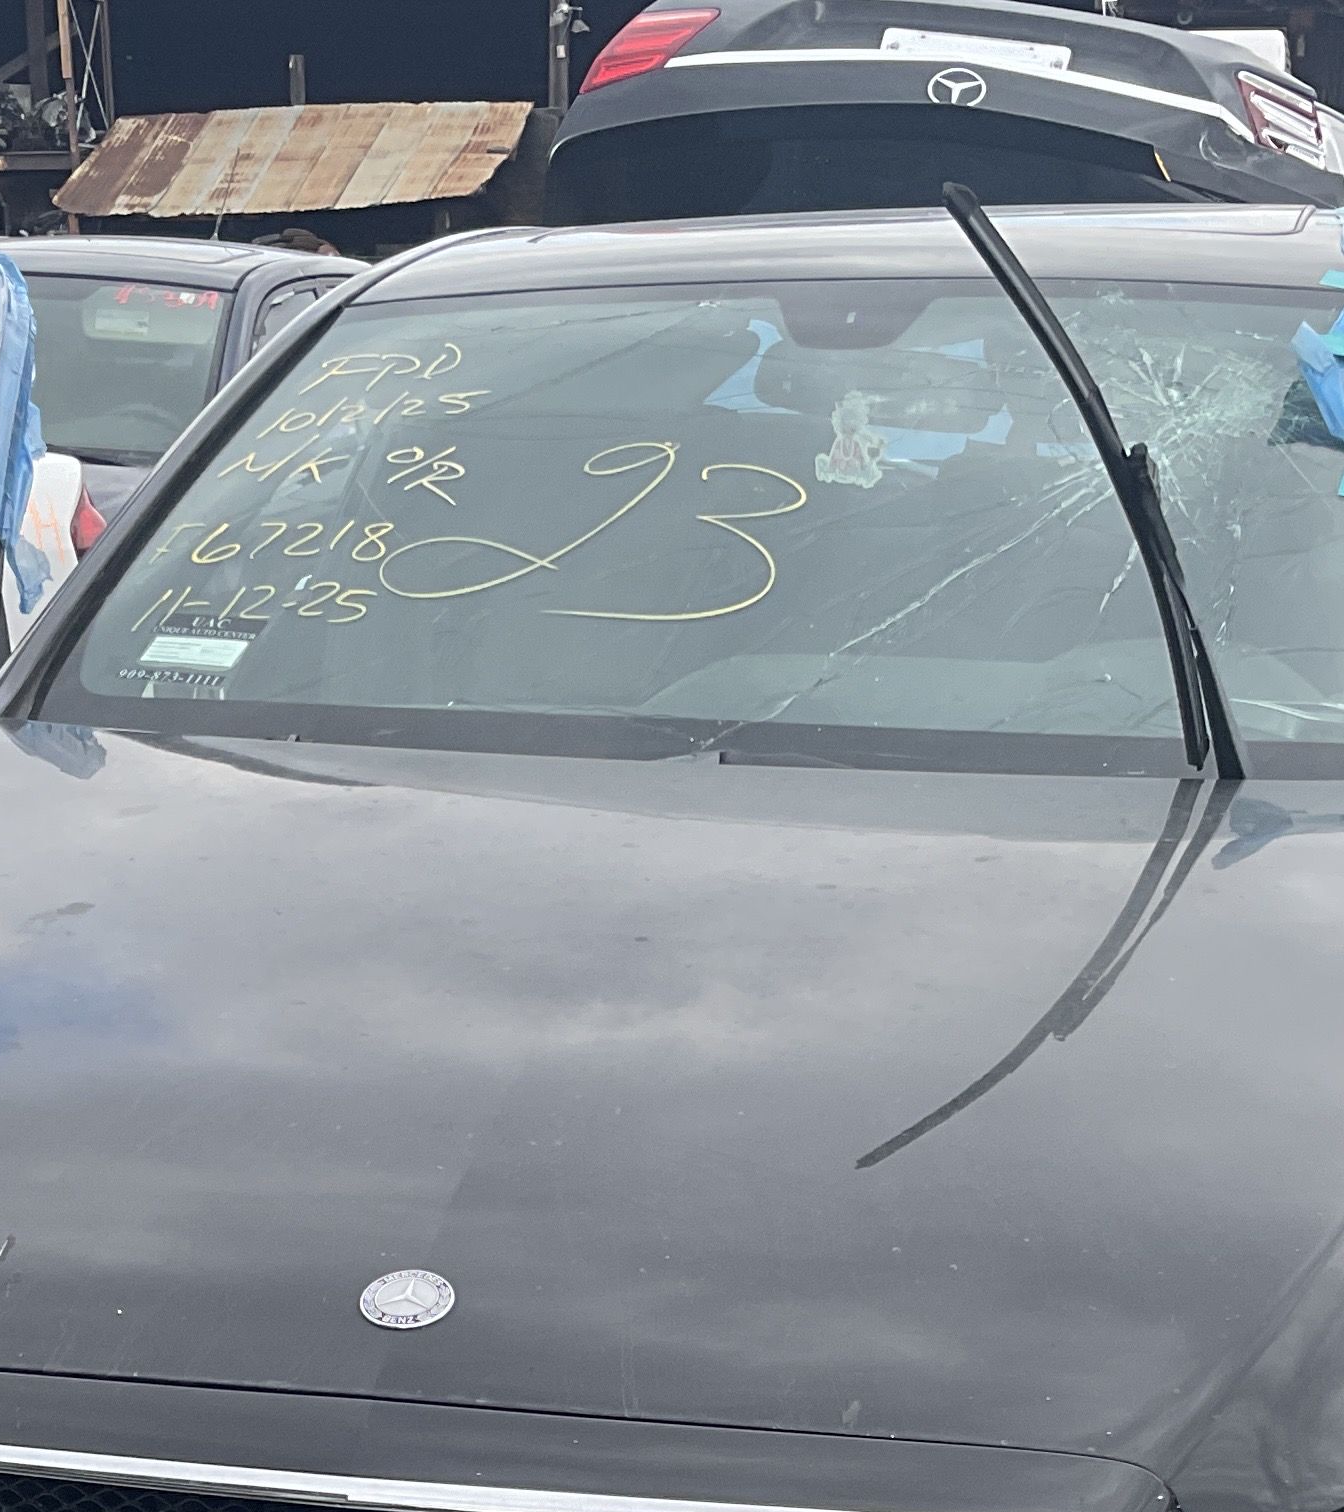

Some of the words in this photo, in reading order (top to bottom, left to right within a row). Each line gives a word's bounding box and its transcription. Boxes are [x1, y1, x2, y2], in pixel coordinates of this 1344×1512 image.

[256, 390, 492, 440] 10/2/25
[149, 520, 394, 565] F67218
[131, 581, 378, 633] 11-12-25
[191, 616, 232, 628] UAC
[119, 668, 221, 686] 909-873-1111
